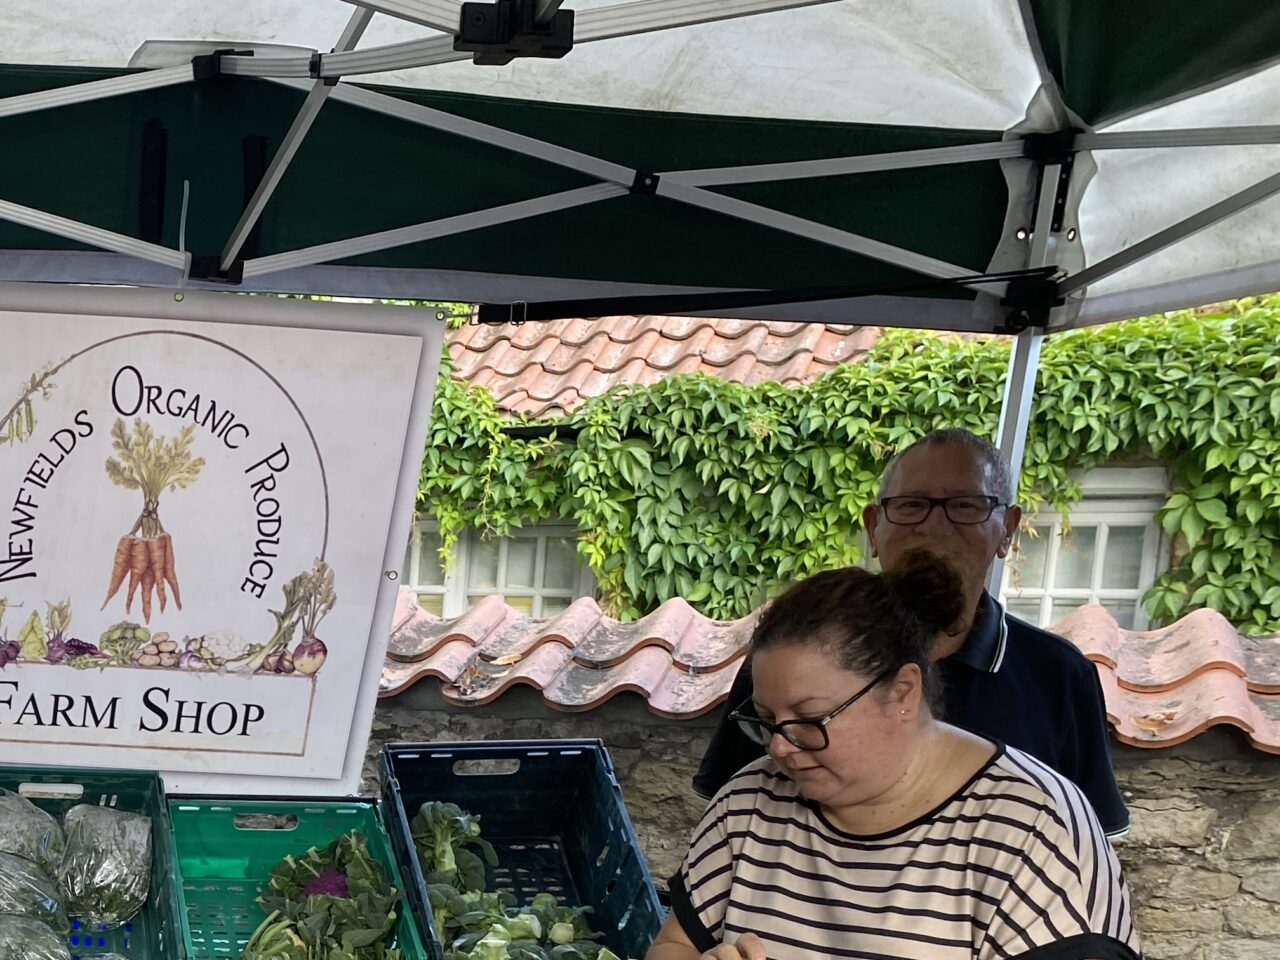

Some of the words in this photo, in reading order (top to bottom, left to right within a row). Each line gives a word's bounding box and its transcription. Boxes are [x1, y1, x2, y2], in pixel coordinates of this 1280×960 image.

[111, 365, 250, 450] ORGANIC
[240, 442, 290, 599] PRODUCE
[138, 686, 266, 737] SHOP
